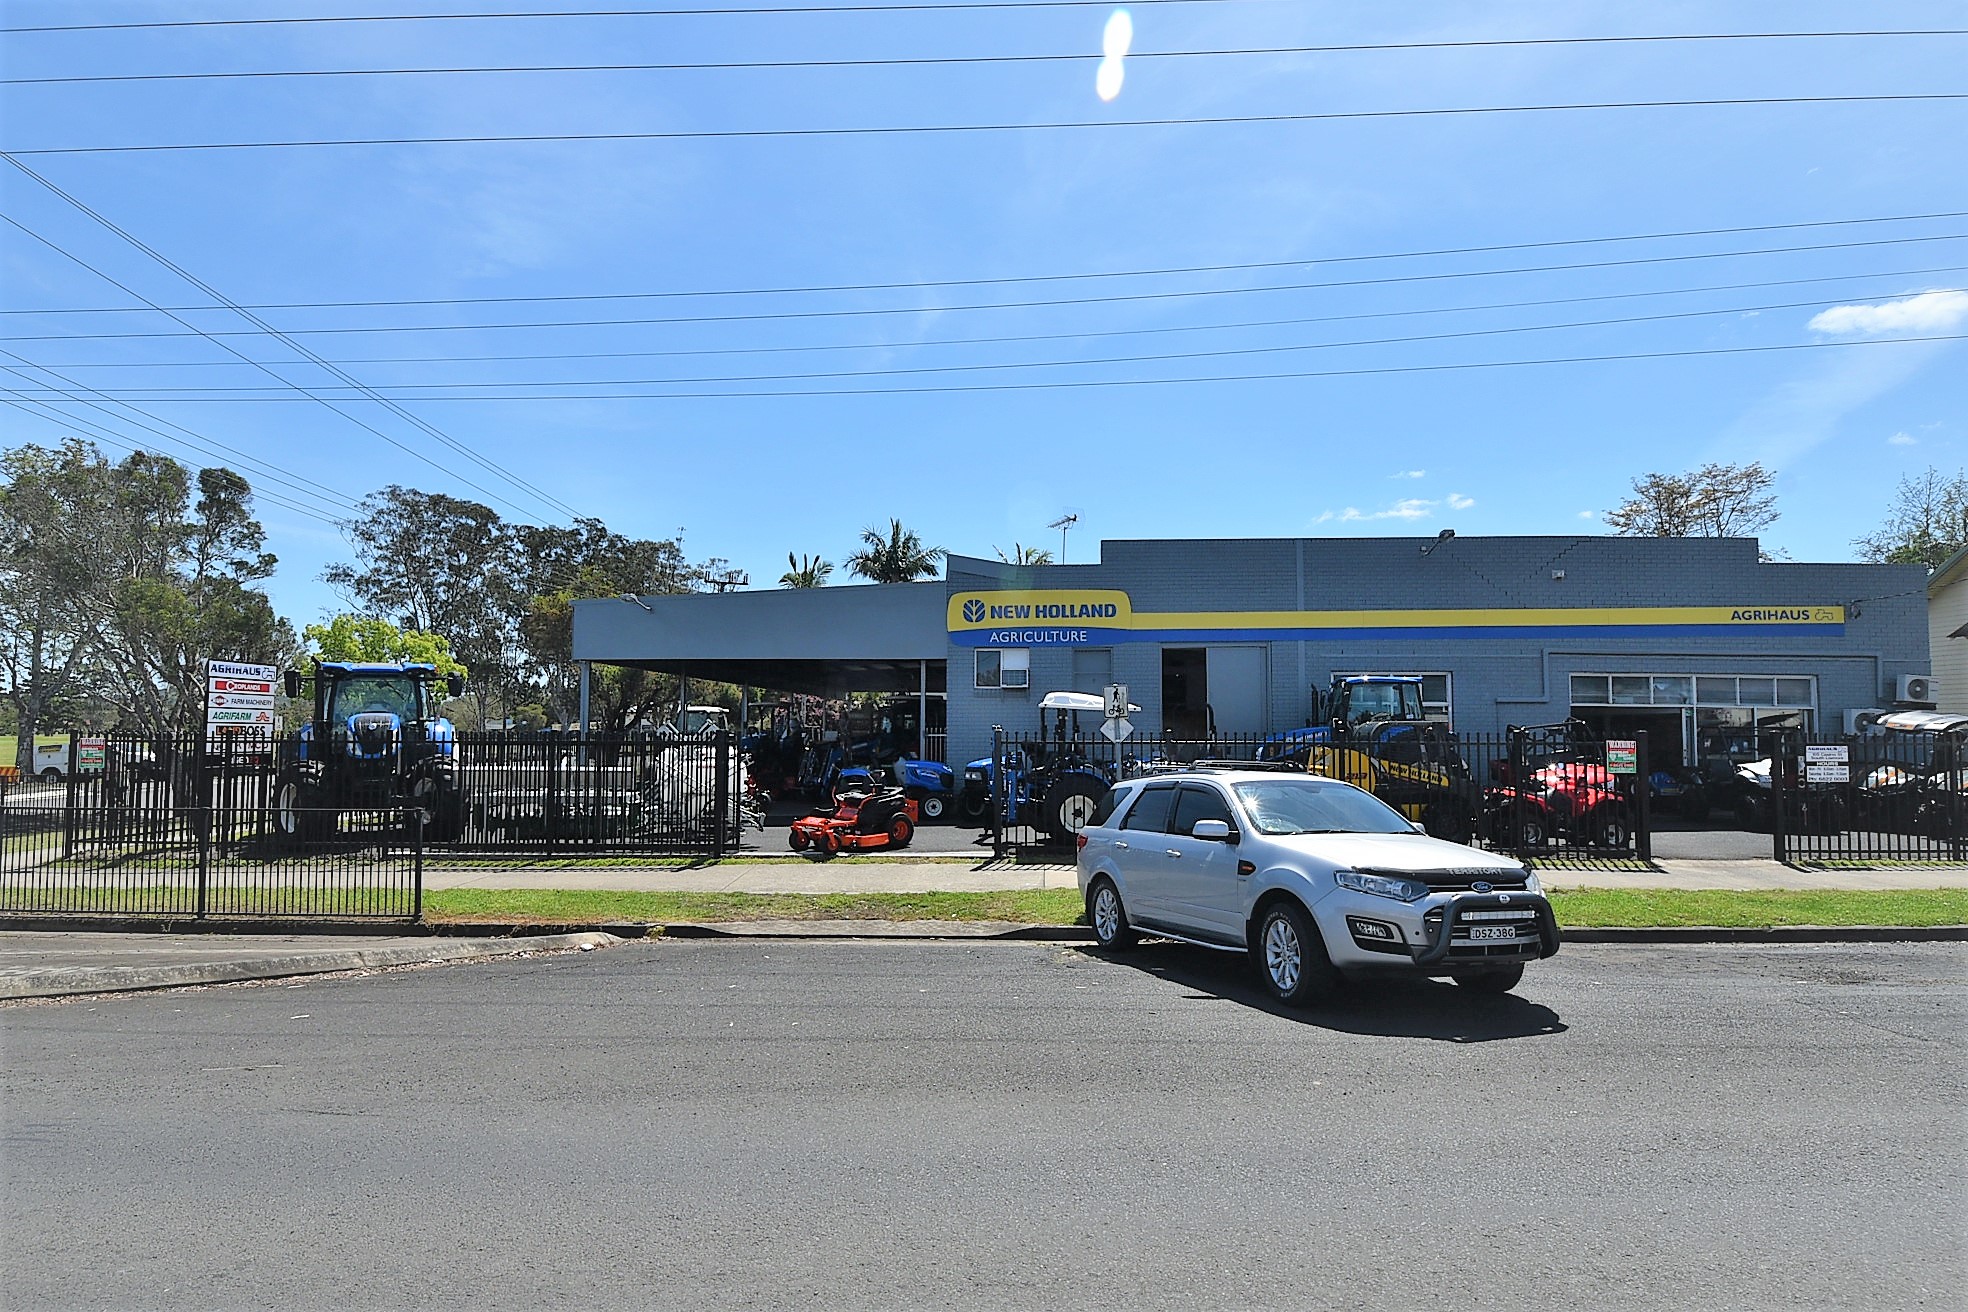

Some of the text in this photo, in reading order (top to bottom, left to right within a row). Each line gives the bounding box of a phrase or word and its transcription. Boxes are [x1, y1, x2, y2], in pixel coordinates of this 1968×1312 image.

[990, 603, 1117, 619] NEW HOLLAND
[1731, 609, 1810, 620] AGRIHAUS
[989, 630, 1088, 643] AGRICULTURE
[211, 664, 261, 675] AGRIHAUS
[213, 712, 252, 720] AGRIFARM
[1447, 868, 1503, 876] TERRITORY
